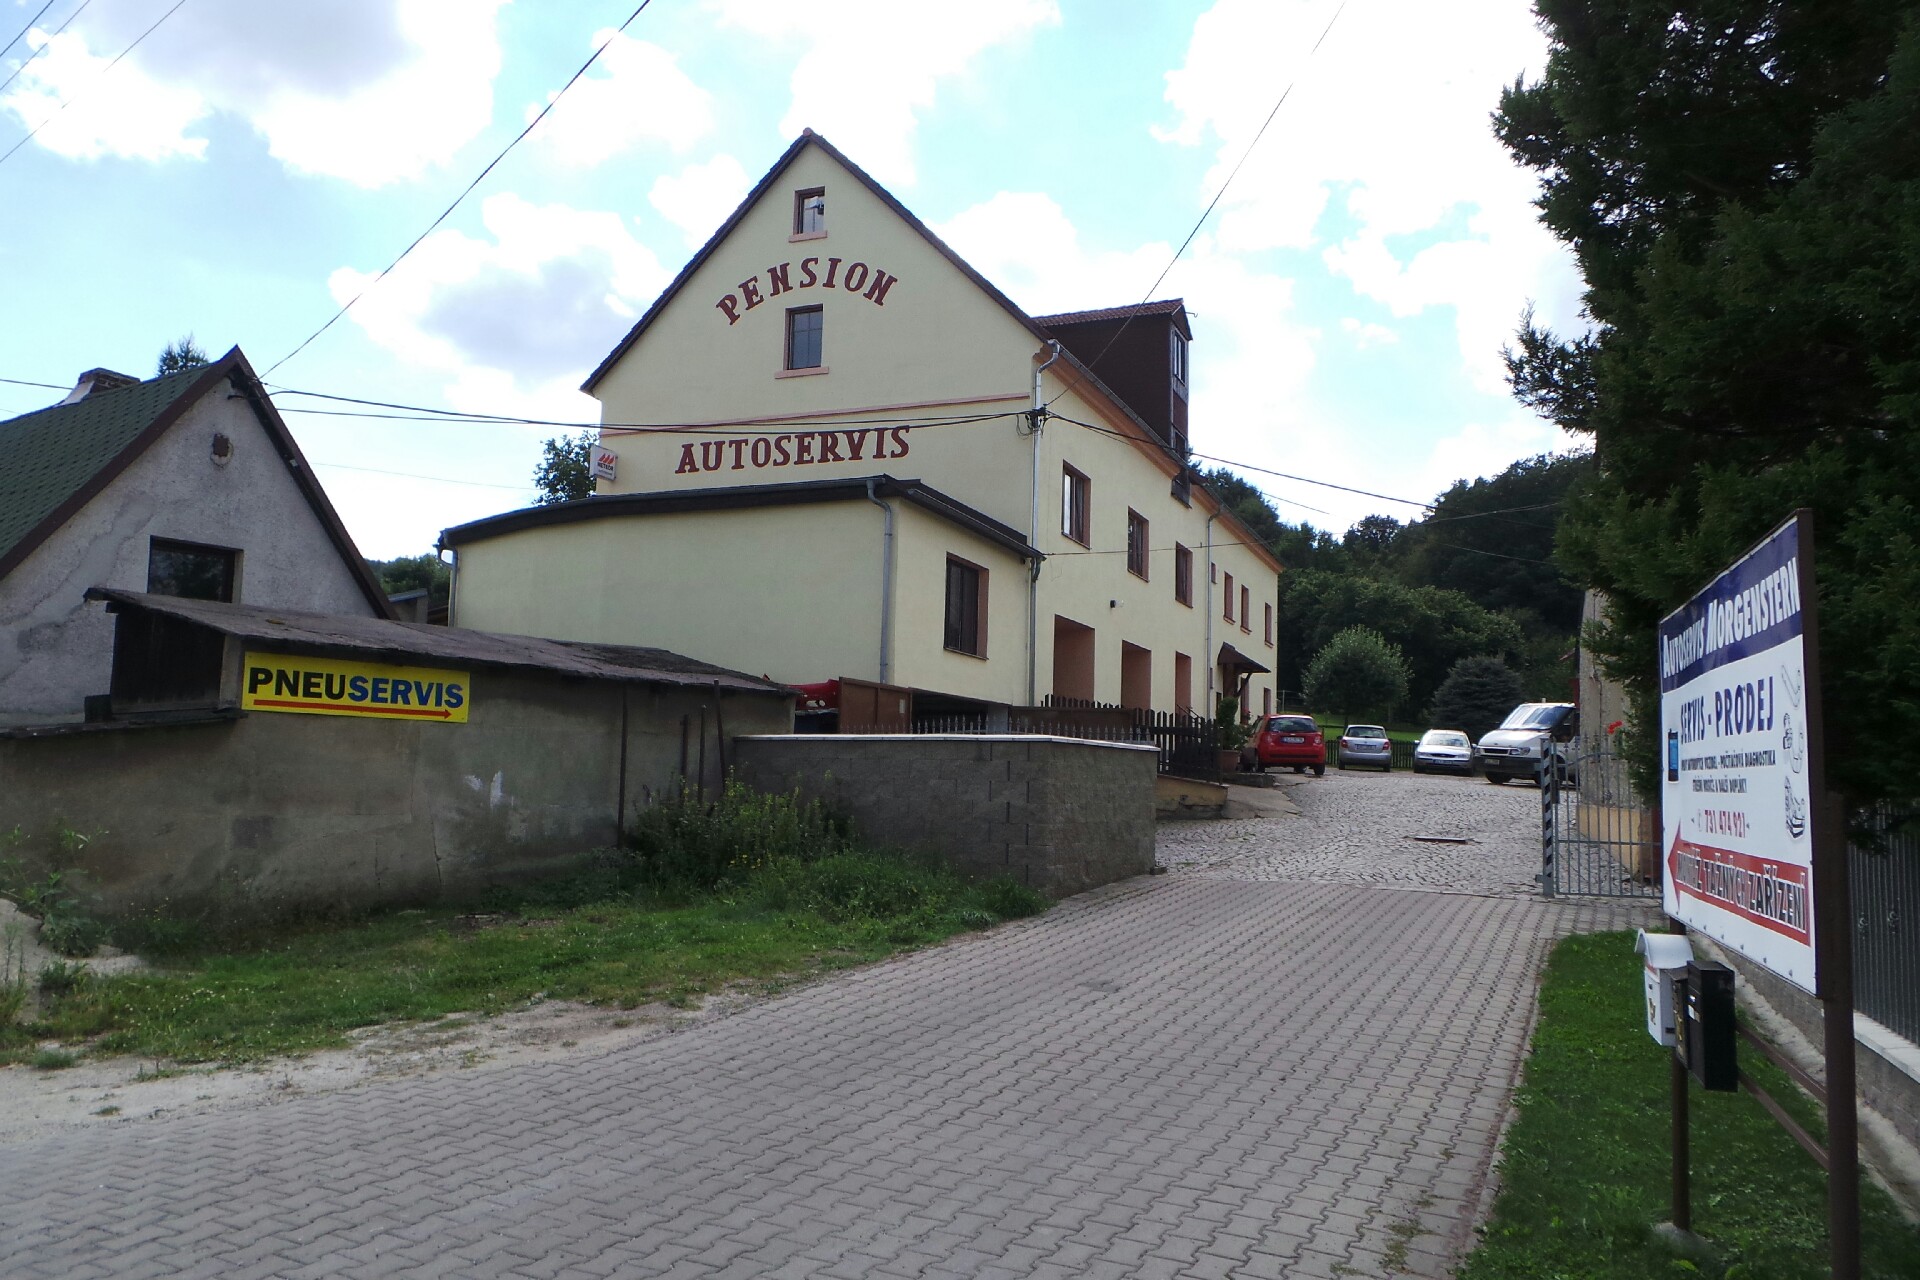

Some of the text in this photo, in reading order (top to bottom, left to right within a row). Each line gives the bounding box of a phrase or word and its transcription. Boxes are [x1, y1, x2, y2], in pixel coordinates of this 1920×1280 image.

[715, 257, 898, 325] PENSION
[674, 425, 910, 474] AUTOSERVIS
[1663, 557, 1800, 679] AUTOSERVIS MORGENSTERN
[248, 667, 464, 709] PNEUSERVIS
[1680, 696, 1705, 744] SERVIS
[1715, 676, 1774, 737] PRODEJ
[1704, 809, 1746, 838] 731 474 921
[1747, 864, 1806, 934] ZAŘÍZENÍ
